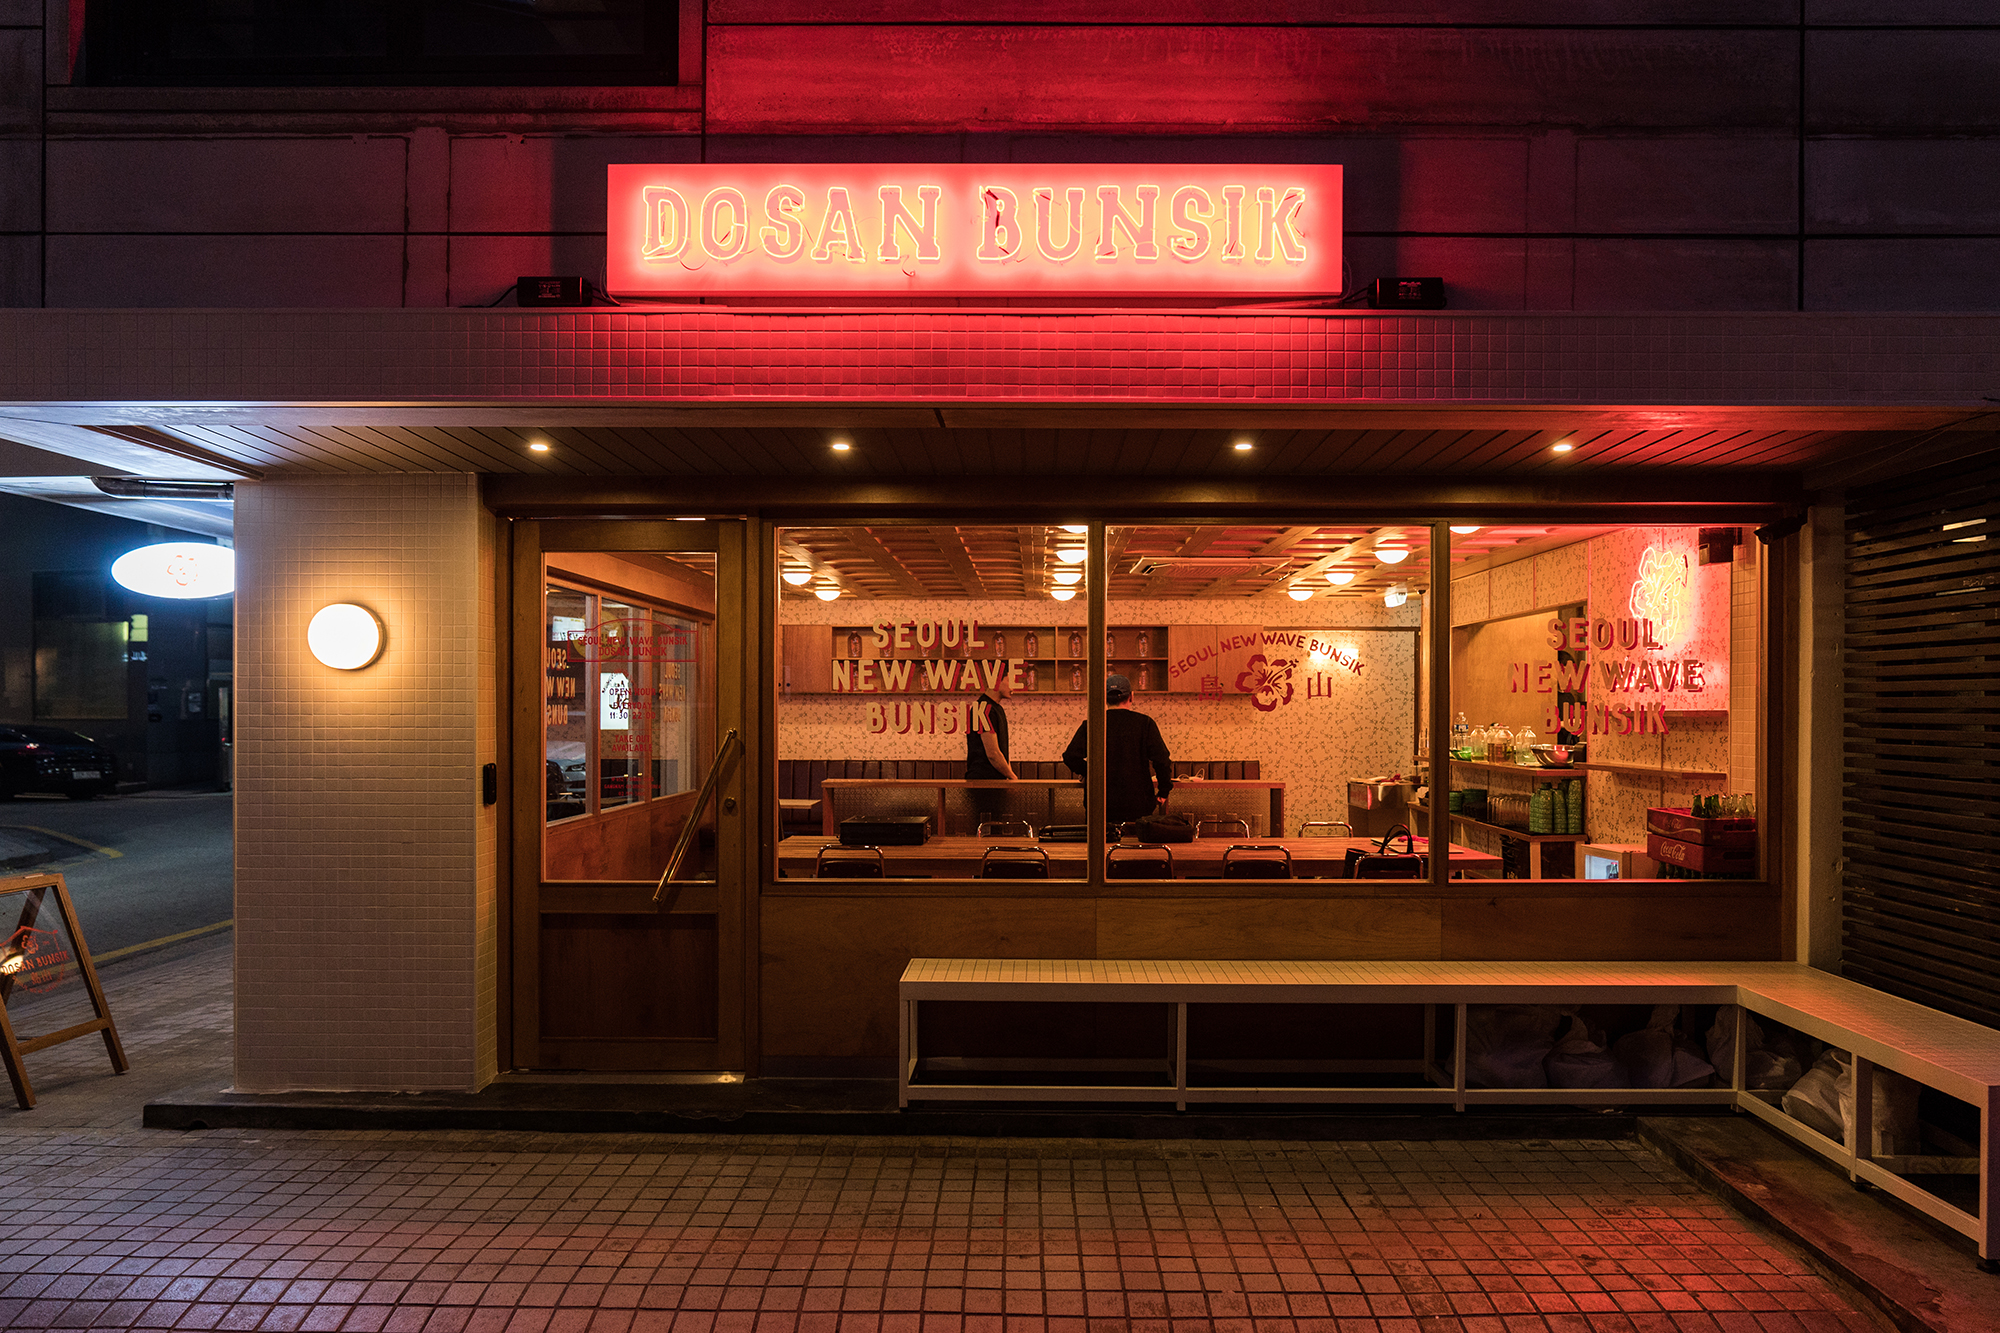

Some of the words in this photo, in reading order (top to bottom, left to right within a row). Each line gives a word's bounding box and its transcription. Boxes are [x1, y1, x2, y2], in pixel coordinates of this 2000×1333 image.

[642, 184, 942, 264] DOSAN
[975, 184, 1307, 263] BUNSIK
[578, 637, 602, 645] SEOUL
[607, 637, 627, 645] NEW
[629, 637, 654, 645] WAVE
[658, 637, 688, 645] BUNSIK
[872, 617, 988, 650] SEOUL
[1547, 617, 1663, 650] SEOUL
[599, 646, 629, 656] DOSAN
[633, 646, 667, 656] BUNSIK
[1169, 645, 1218, 678] SEOUL
[1220, 632, 1257, 653] NEW
[1260, 631, 1306, 649] WAVE
[1309, 639, 1365, 676] BUNSIK
[832, 659, 916, 692] NEW
[924, 658, 1028, 692] WAVE
[1307, 672, 1332, 699] 山
[1508, 659, 1590, 693] NEW
[1600, 659, 1705, 693] WAVE
[609, 688, 631, 696] OPEN
[634, 688, 656, 696] HOUR
[613, 702, 652, 710] EVERYDAY
[866, 701, 996, 734] BUNSIK
[1541, 702, 1669, 735] BUNSIK
[612, 744, 653, 752] AVAILABLE
[615, 735, 633, 743] TAKE
[635, 735, 650, 743] OUT
[0, 959, 35, 976] DOSAN
[36, 950, 70, 967] BUNSIK
